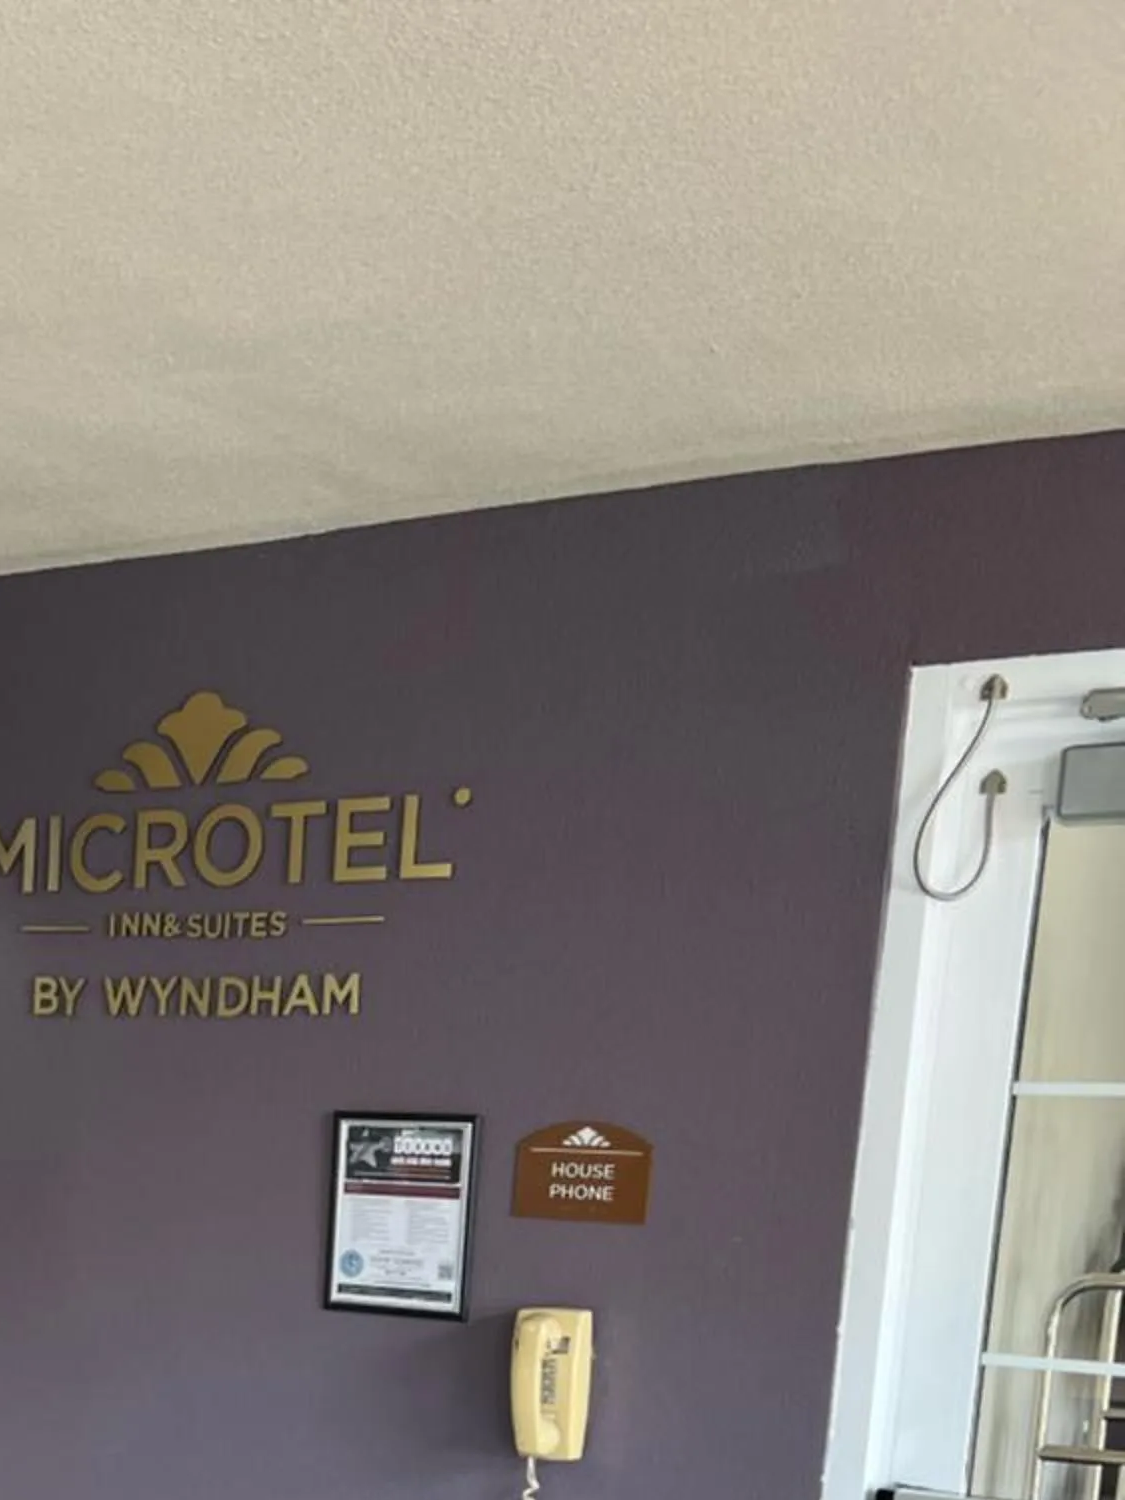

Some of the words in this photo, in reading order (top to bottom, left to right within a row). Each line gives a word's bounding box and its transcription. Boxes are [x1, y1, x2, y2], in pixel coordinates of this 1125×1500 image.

[32, 975, 86, 1017] BY
[104, 973, 362, 1018] WYNDHAM
[551, 1161, 615, 1180] HOUSE
[548, 1182, 615, 1202] PHONE
